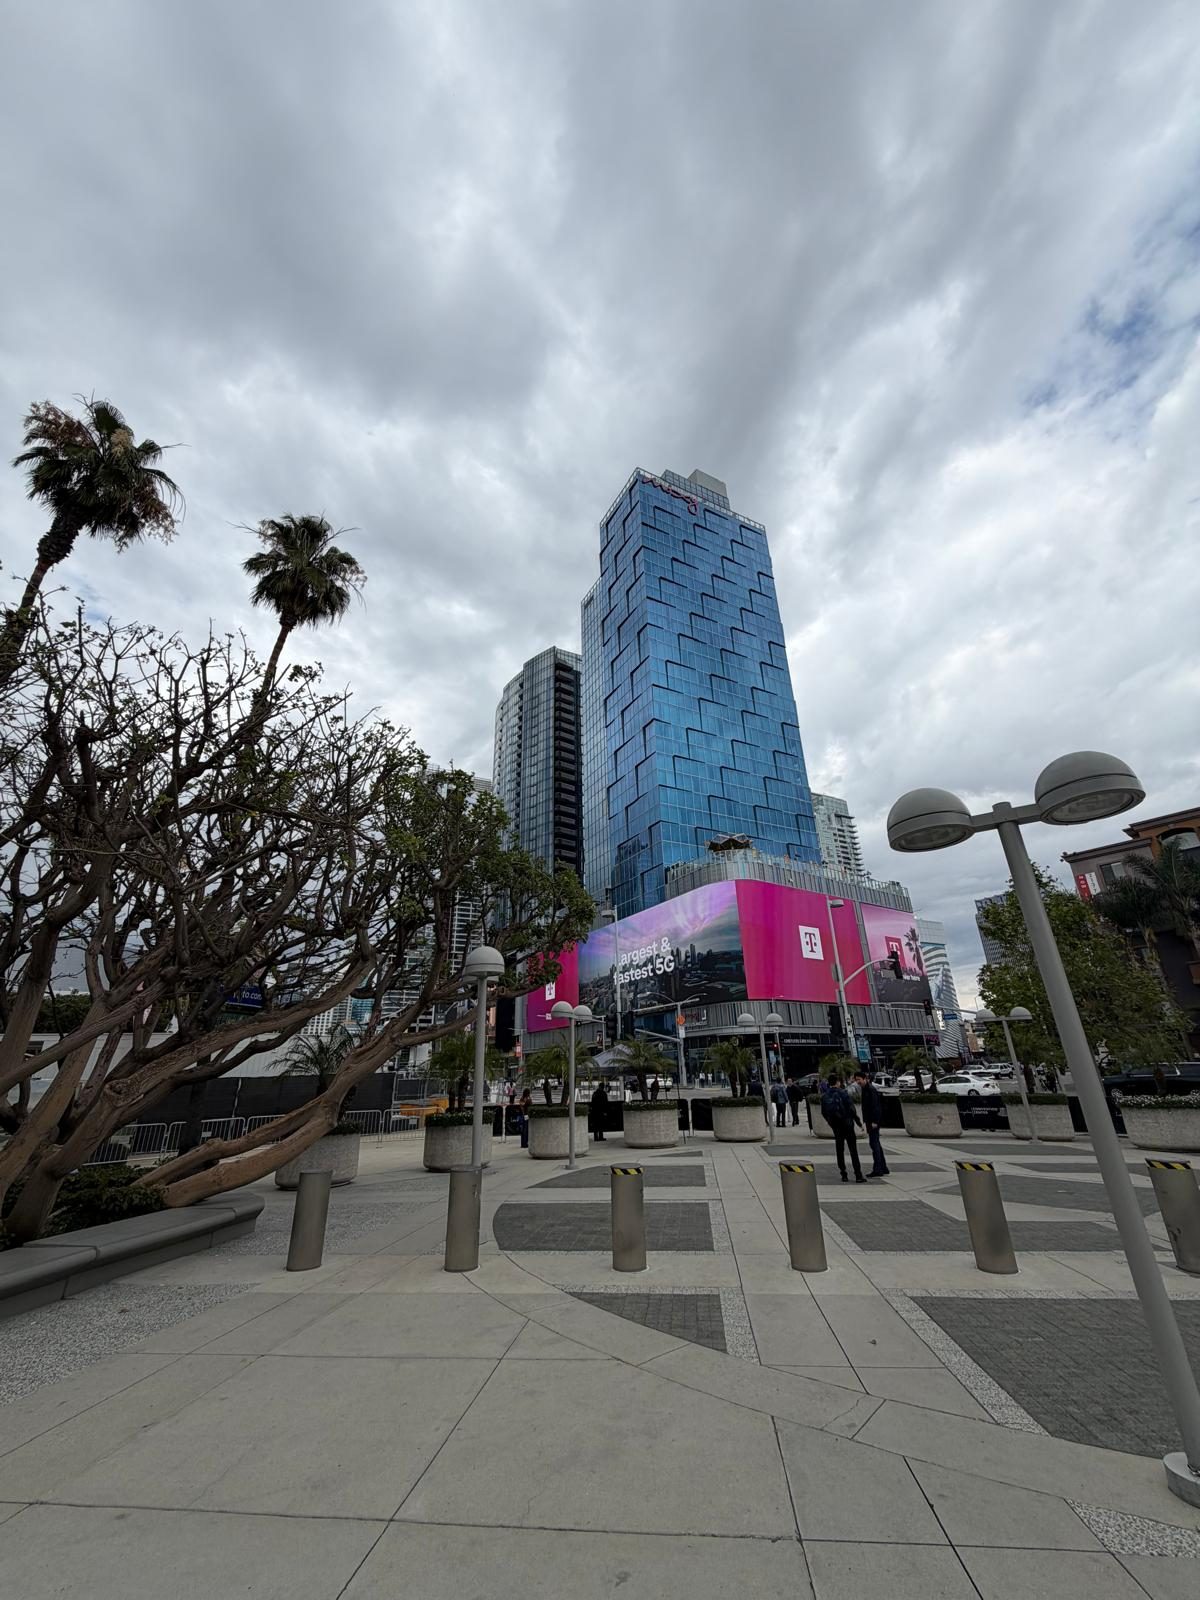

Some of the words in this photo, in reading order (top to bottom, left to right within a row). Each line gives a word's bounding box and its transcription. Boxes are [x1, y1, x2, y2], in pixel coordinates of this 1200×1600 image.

[660, 936, 672, 953] &
[804, 932, 817, 954] T
[655, 955, 675, 975] 5G
